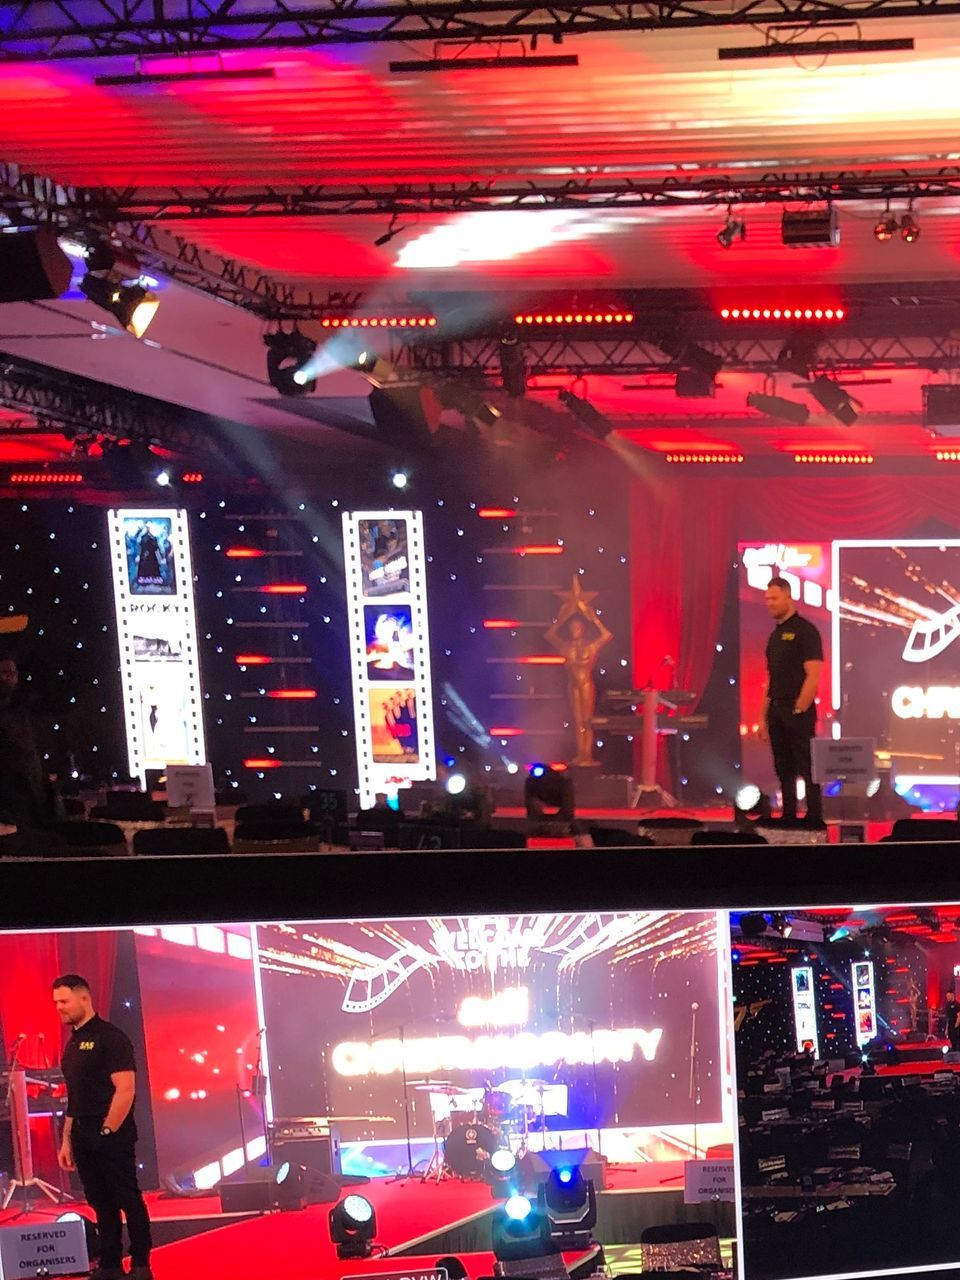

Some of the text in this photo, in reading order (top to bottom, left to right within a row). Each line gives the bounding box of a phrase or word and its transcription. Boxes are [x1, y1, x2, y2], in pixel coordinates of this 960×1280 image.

[20, 1230, 67, 1242] RESERVED
[37, 1244, 55, 1254] FOR
[19, 1255, 77, 1269] ORGANISERS
